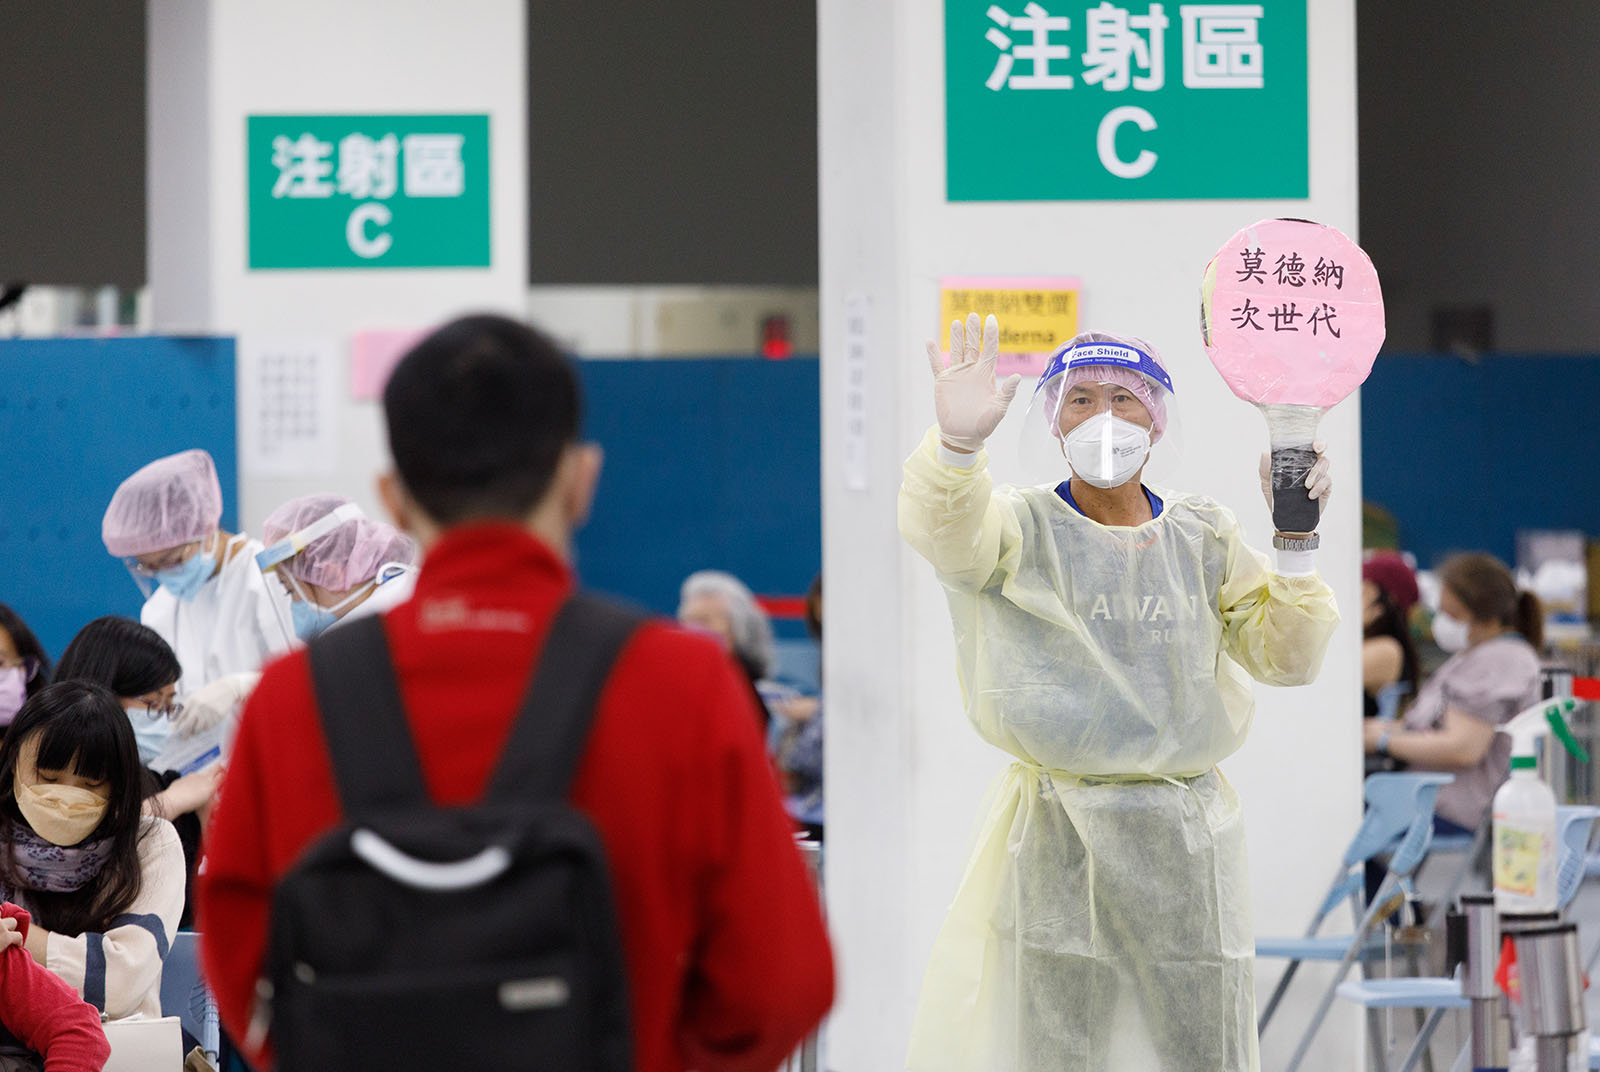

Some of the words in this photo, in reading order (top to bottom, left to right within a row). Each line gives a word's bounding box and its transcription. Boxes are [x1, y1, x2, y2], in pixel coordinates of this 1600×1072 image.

[985, 2, 1264, 91] 注射區
[272, 132, 465, 199] 注射區
[1097, 105, 1158, 179] C
[345, 203, 393, 259] C
[1236, 247, 1344, 290] 莫德納
[1230, 298, 1341, 338] 次世代
[1097, 348, 1129, 357] Shield
